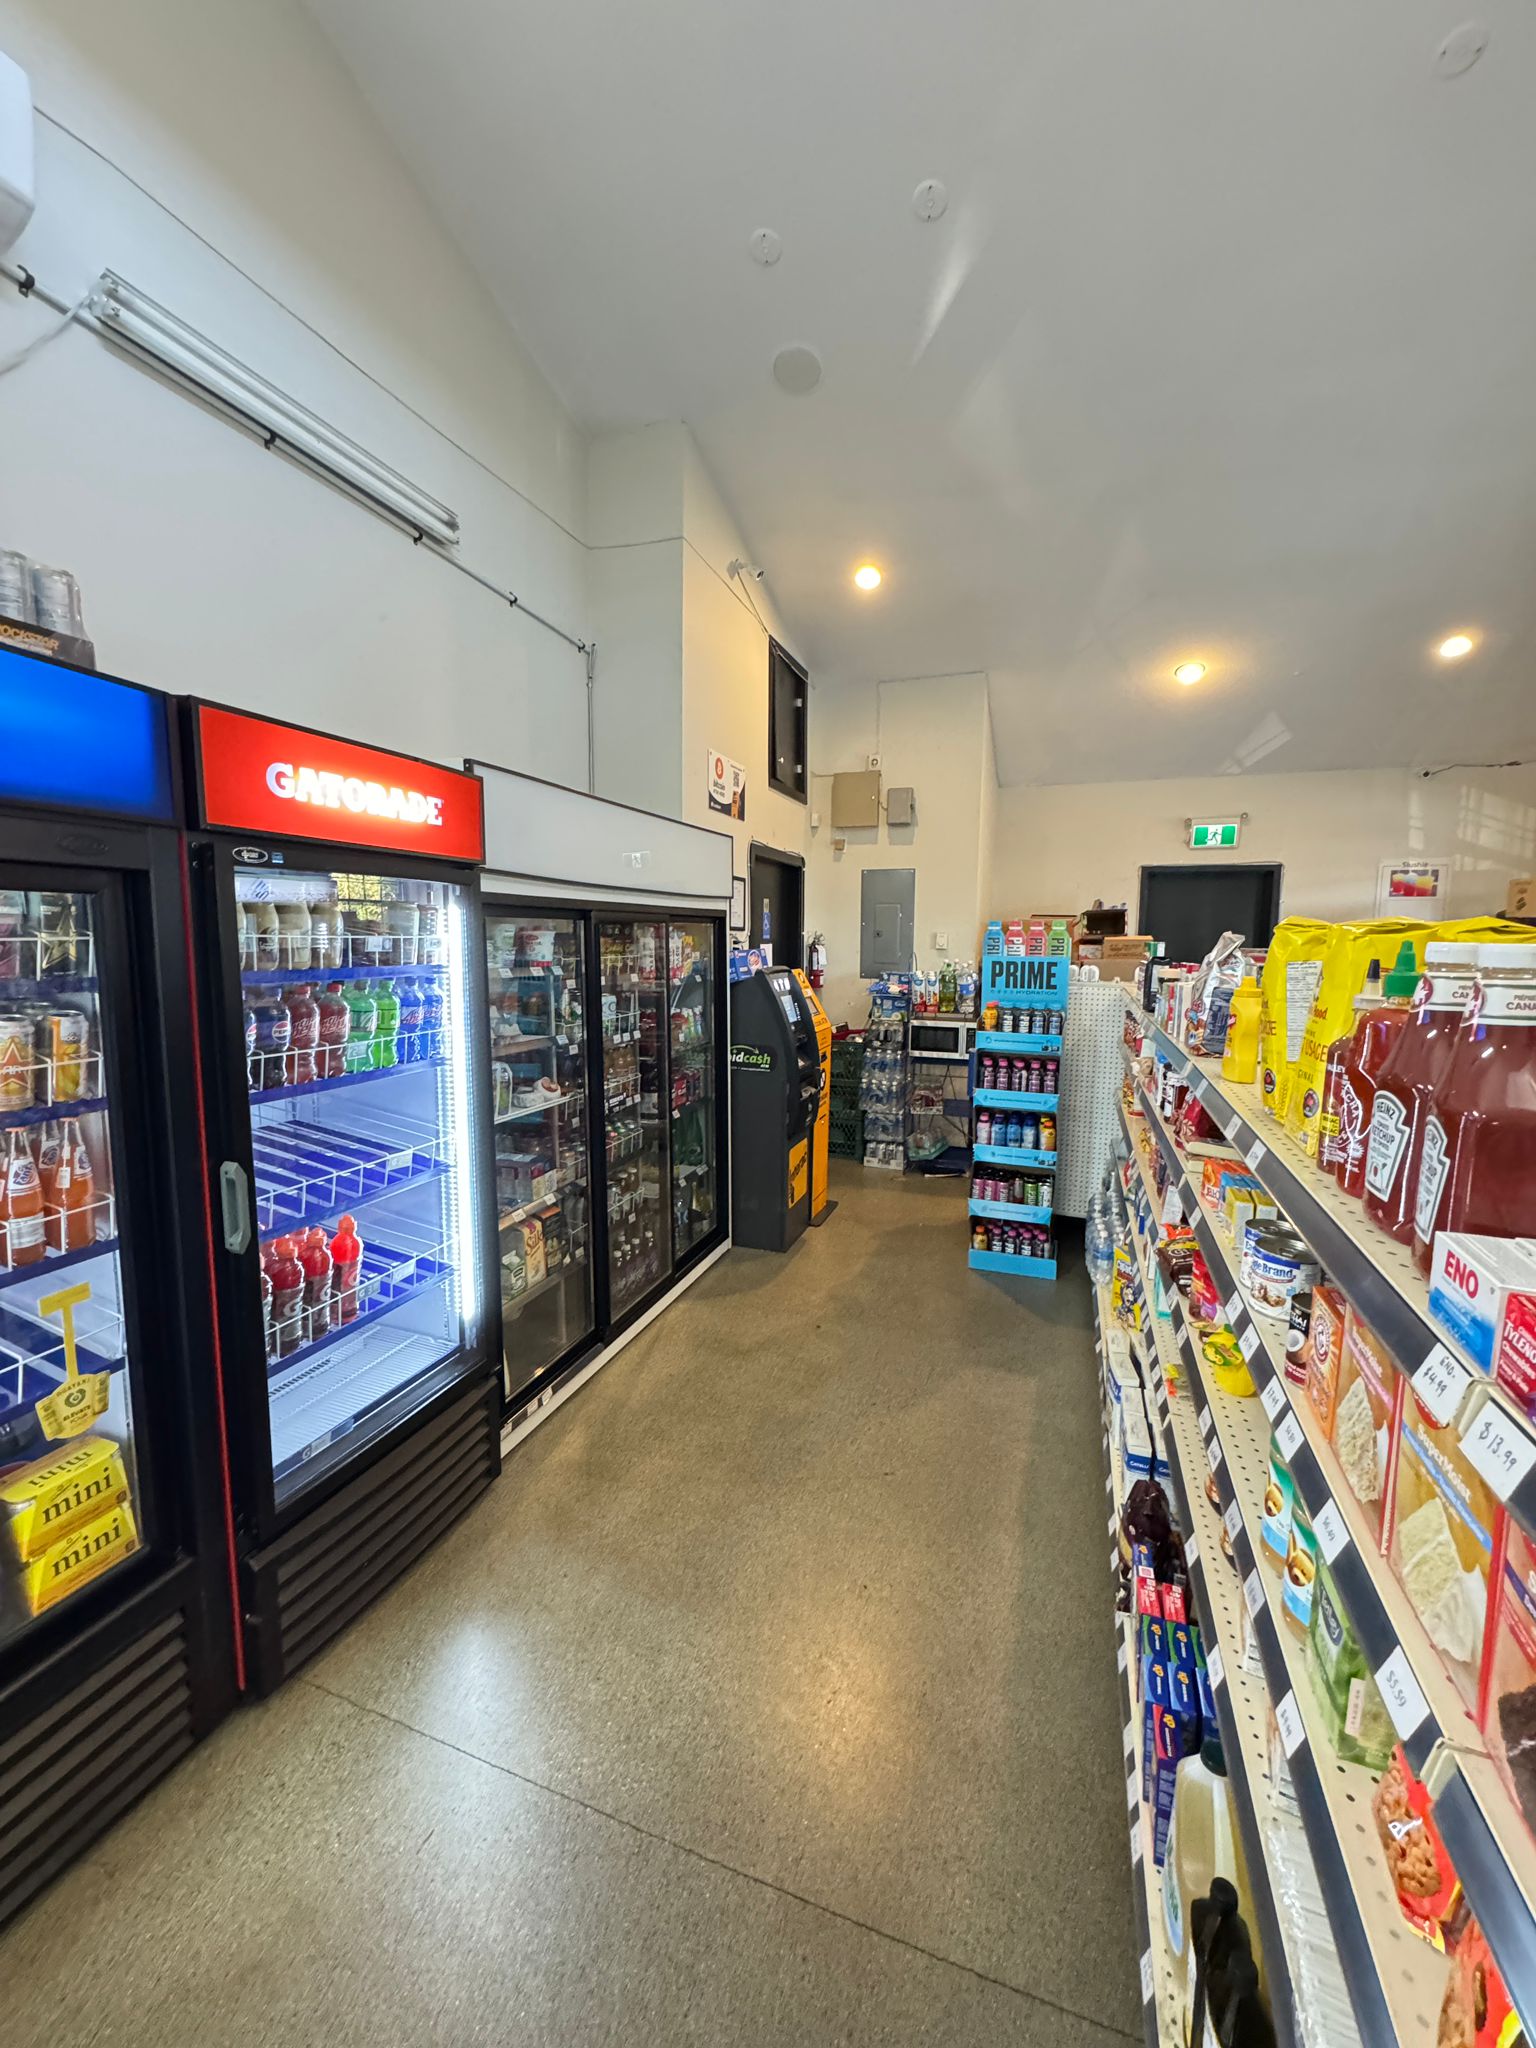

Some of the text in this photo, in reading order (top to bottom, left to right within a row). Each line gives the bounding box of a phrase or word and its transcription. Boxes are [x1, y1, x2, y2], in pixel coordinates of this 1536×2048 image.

[0, 624, 59, 651] OCKSTAR
[265, 762, 443, 826] GATORADE
[991, 961, 1058, 990] PRIME
[1376, 1101, 1396, 1120] HEINZ
[1262, 1263, 1294, 1278] Brand
[1443, 1249, 1479, 1299] ENO
[283, 1302, 301, 1317] G
[1423, 1366, 1447, 1398] $4.99
[1478, 1421, 1518, 1472] $13.99
[28, 1451, 93, 1488] mini
[42, 1466, 113, 1524] mini
[52, 1517, 123, 1577] mini
